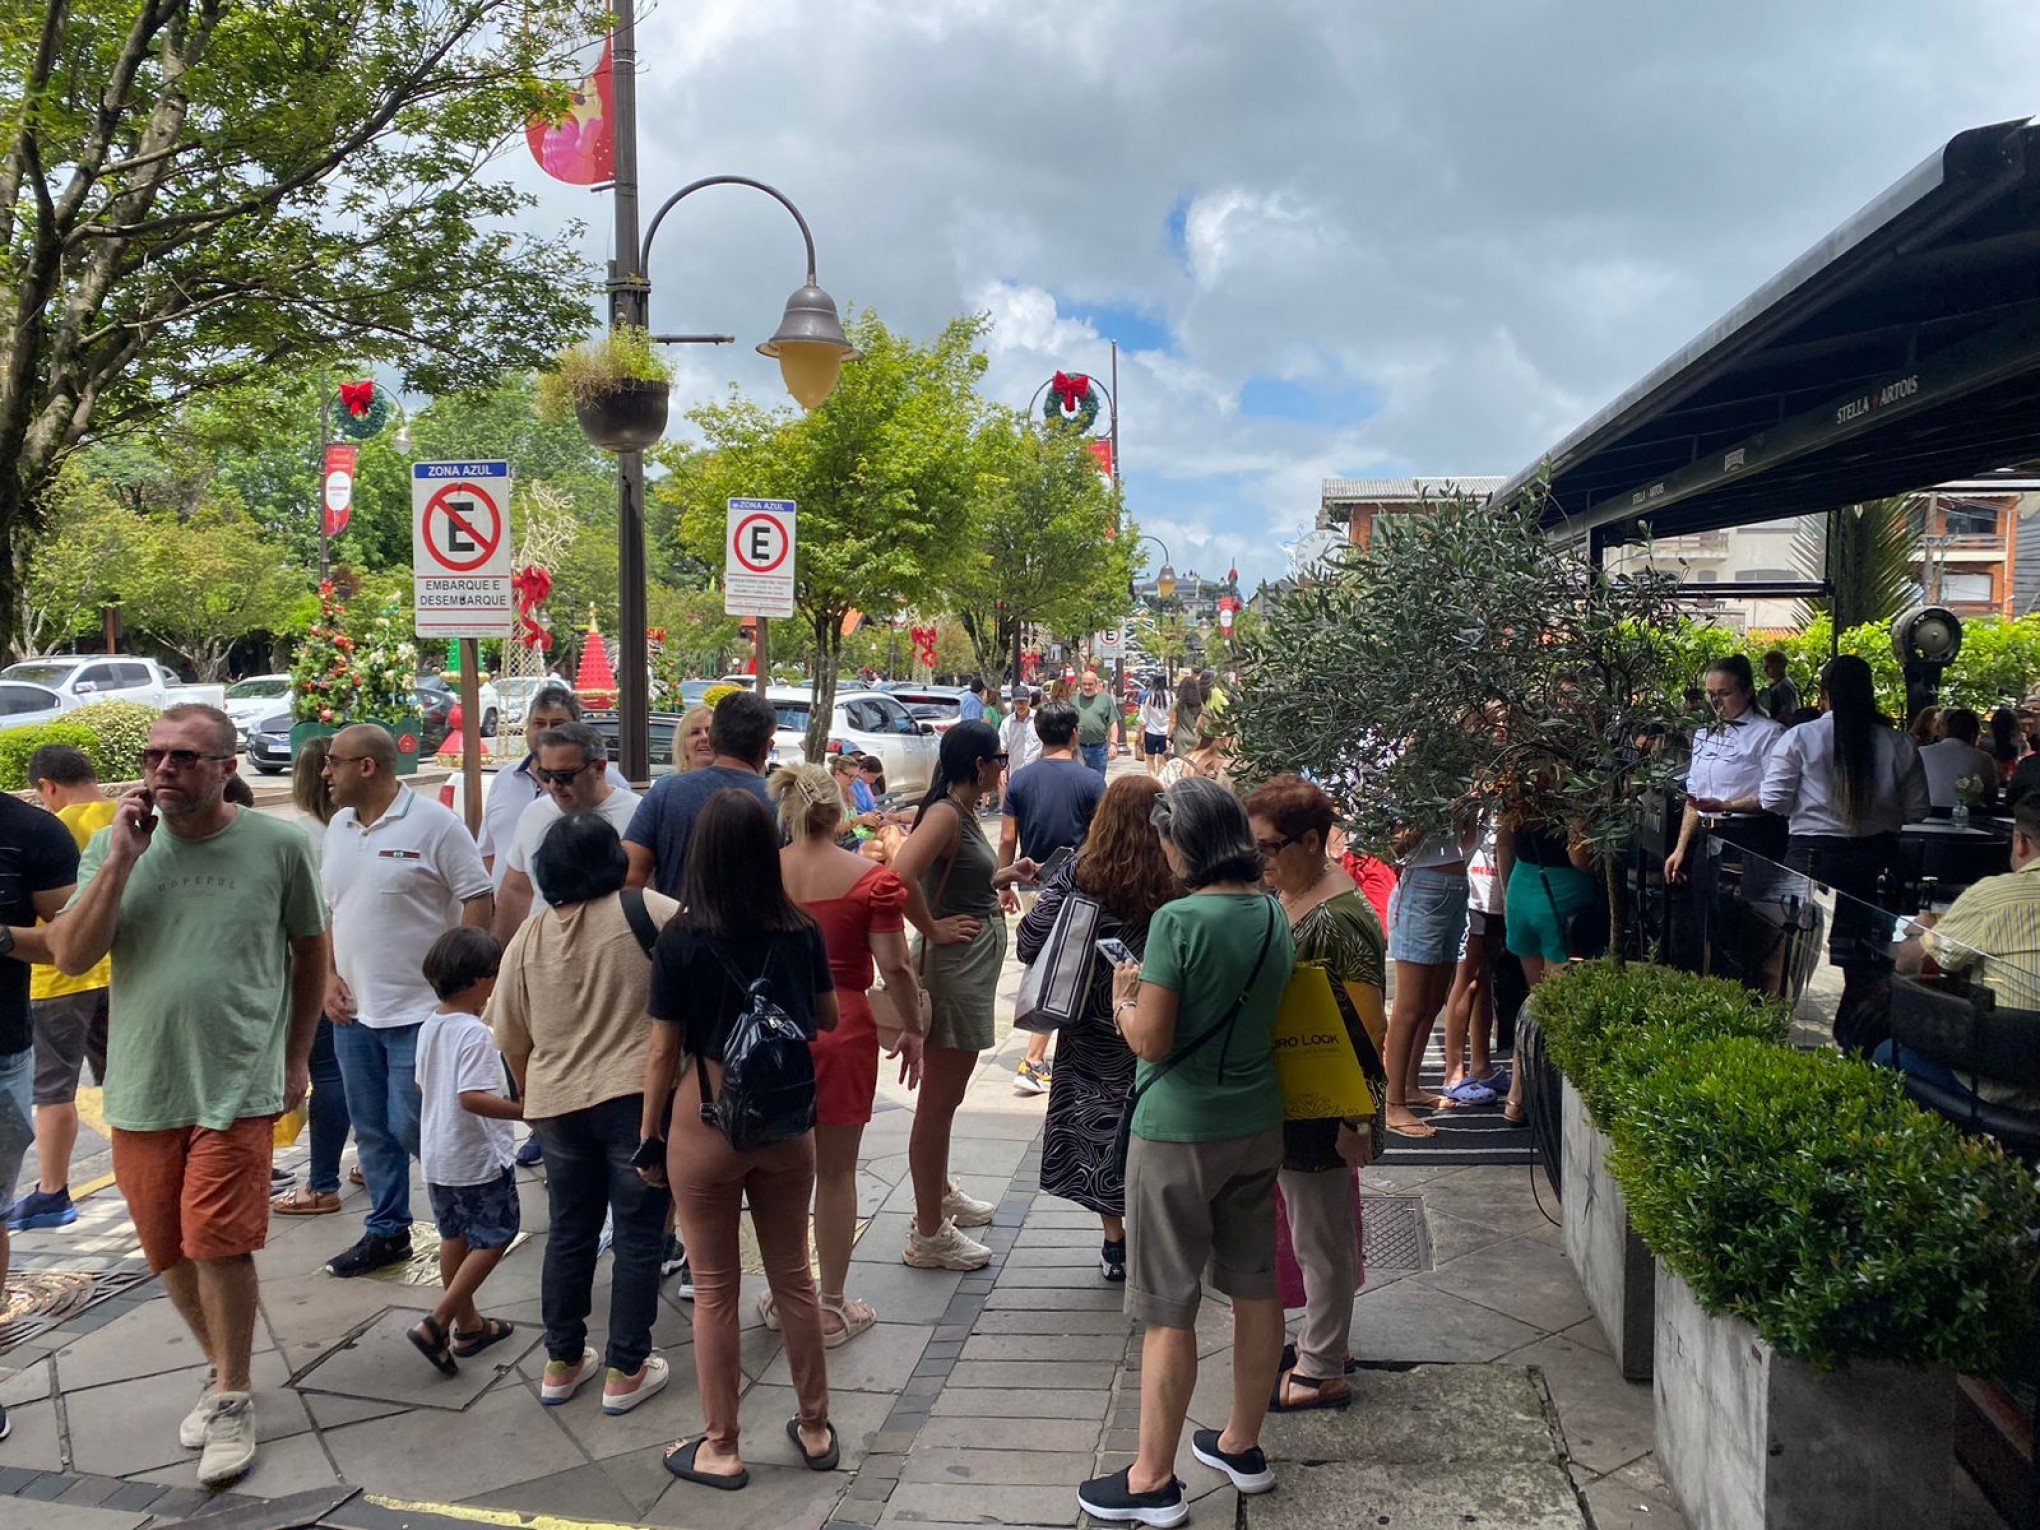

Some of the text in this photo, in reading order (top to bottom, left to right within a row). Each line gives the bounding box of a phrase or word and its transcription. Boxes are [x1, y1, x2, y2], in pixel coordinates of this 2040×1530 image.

[1836, 374, 1918, 425] STELLA ARTOIS
[428, 465, 492, 477] ZONA AZUL
[740, 501, 785, 511] ZONA AZUL
[751, 526, 771, 560] E
[425, 580, 500, 591] EMBARQUE E
[420, 595, 507, 606] DESEMBARQUE
[1301, 1033, 1340, 1046] LOOK
